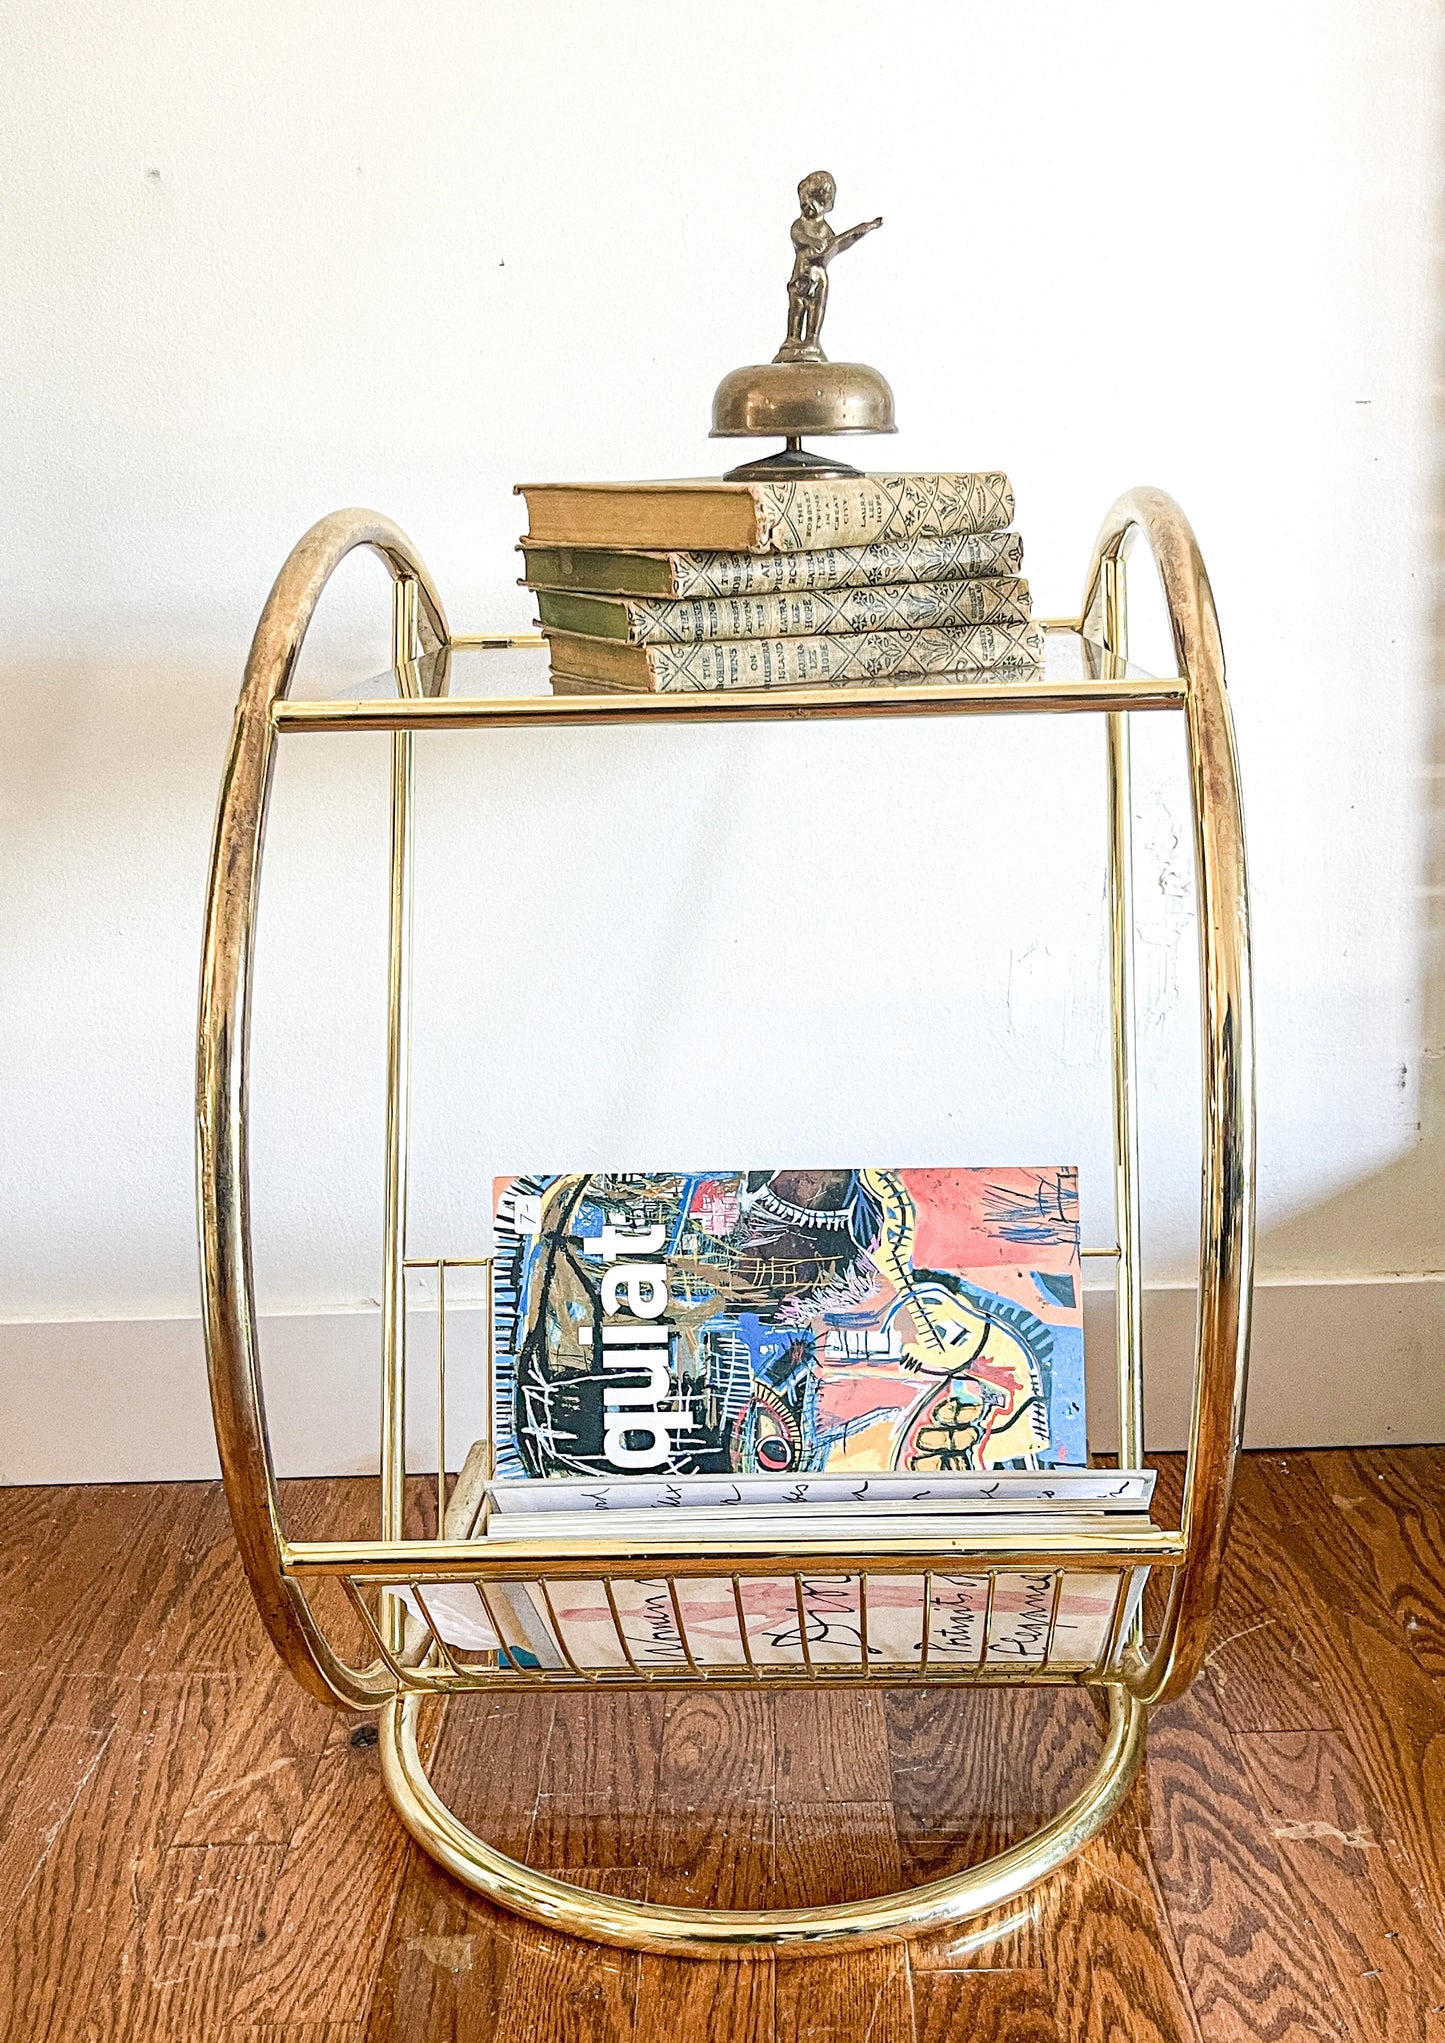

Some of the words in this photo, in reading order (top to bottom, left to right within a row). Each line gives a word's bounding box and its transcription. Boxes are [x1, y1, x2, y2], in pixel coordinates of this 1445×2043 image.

[825, 514, 830, 525] IN
[721, 562, 729, 585] THE
[744, 554, 753, 590] TWINS
[761, 563, 770, 578] AT
[805, 550, 815, 586] LAURA
[817, 557, 825, 577] LEE
[827, 550, 836, 581] HOPE
[680, 609, 689, 633] THE
[708, 601, 718, 637] TWINS
[730, 600, 741, 634] FOREST
[777, 598, 788, 633] LAURA
[792, 604, 800, 624] LEE
[803, 599, 813, 629] HOPE
[702, 656, 711, 680] THE
[729, 648, 739, 684] TWINS
[749, 655, 758, 671] ON
[775, 642, 786, 680] ISLAND
[797, 644, 806, 679] LAURA
[808, 650, 818, 670] LEE
[819, 644, 830, 674] HOPE
[579, 1224, 669, 1469] quiat
